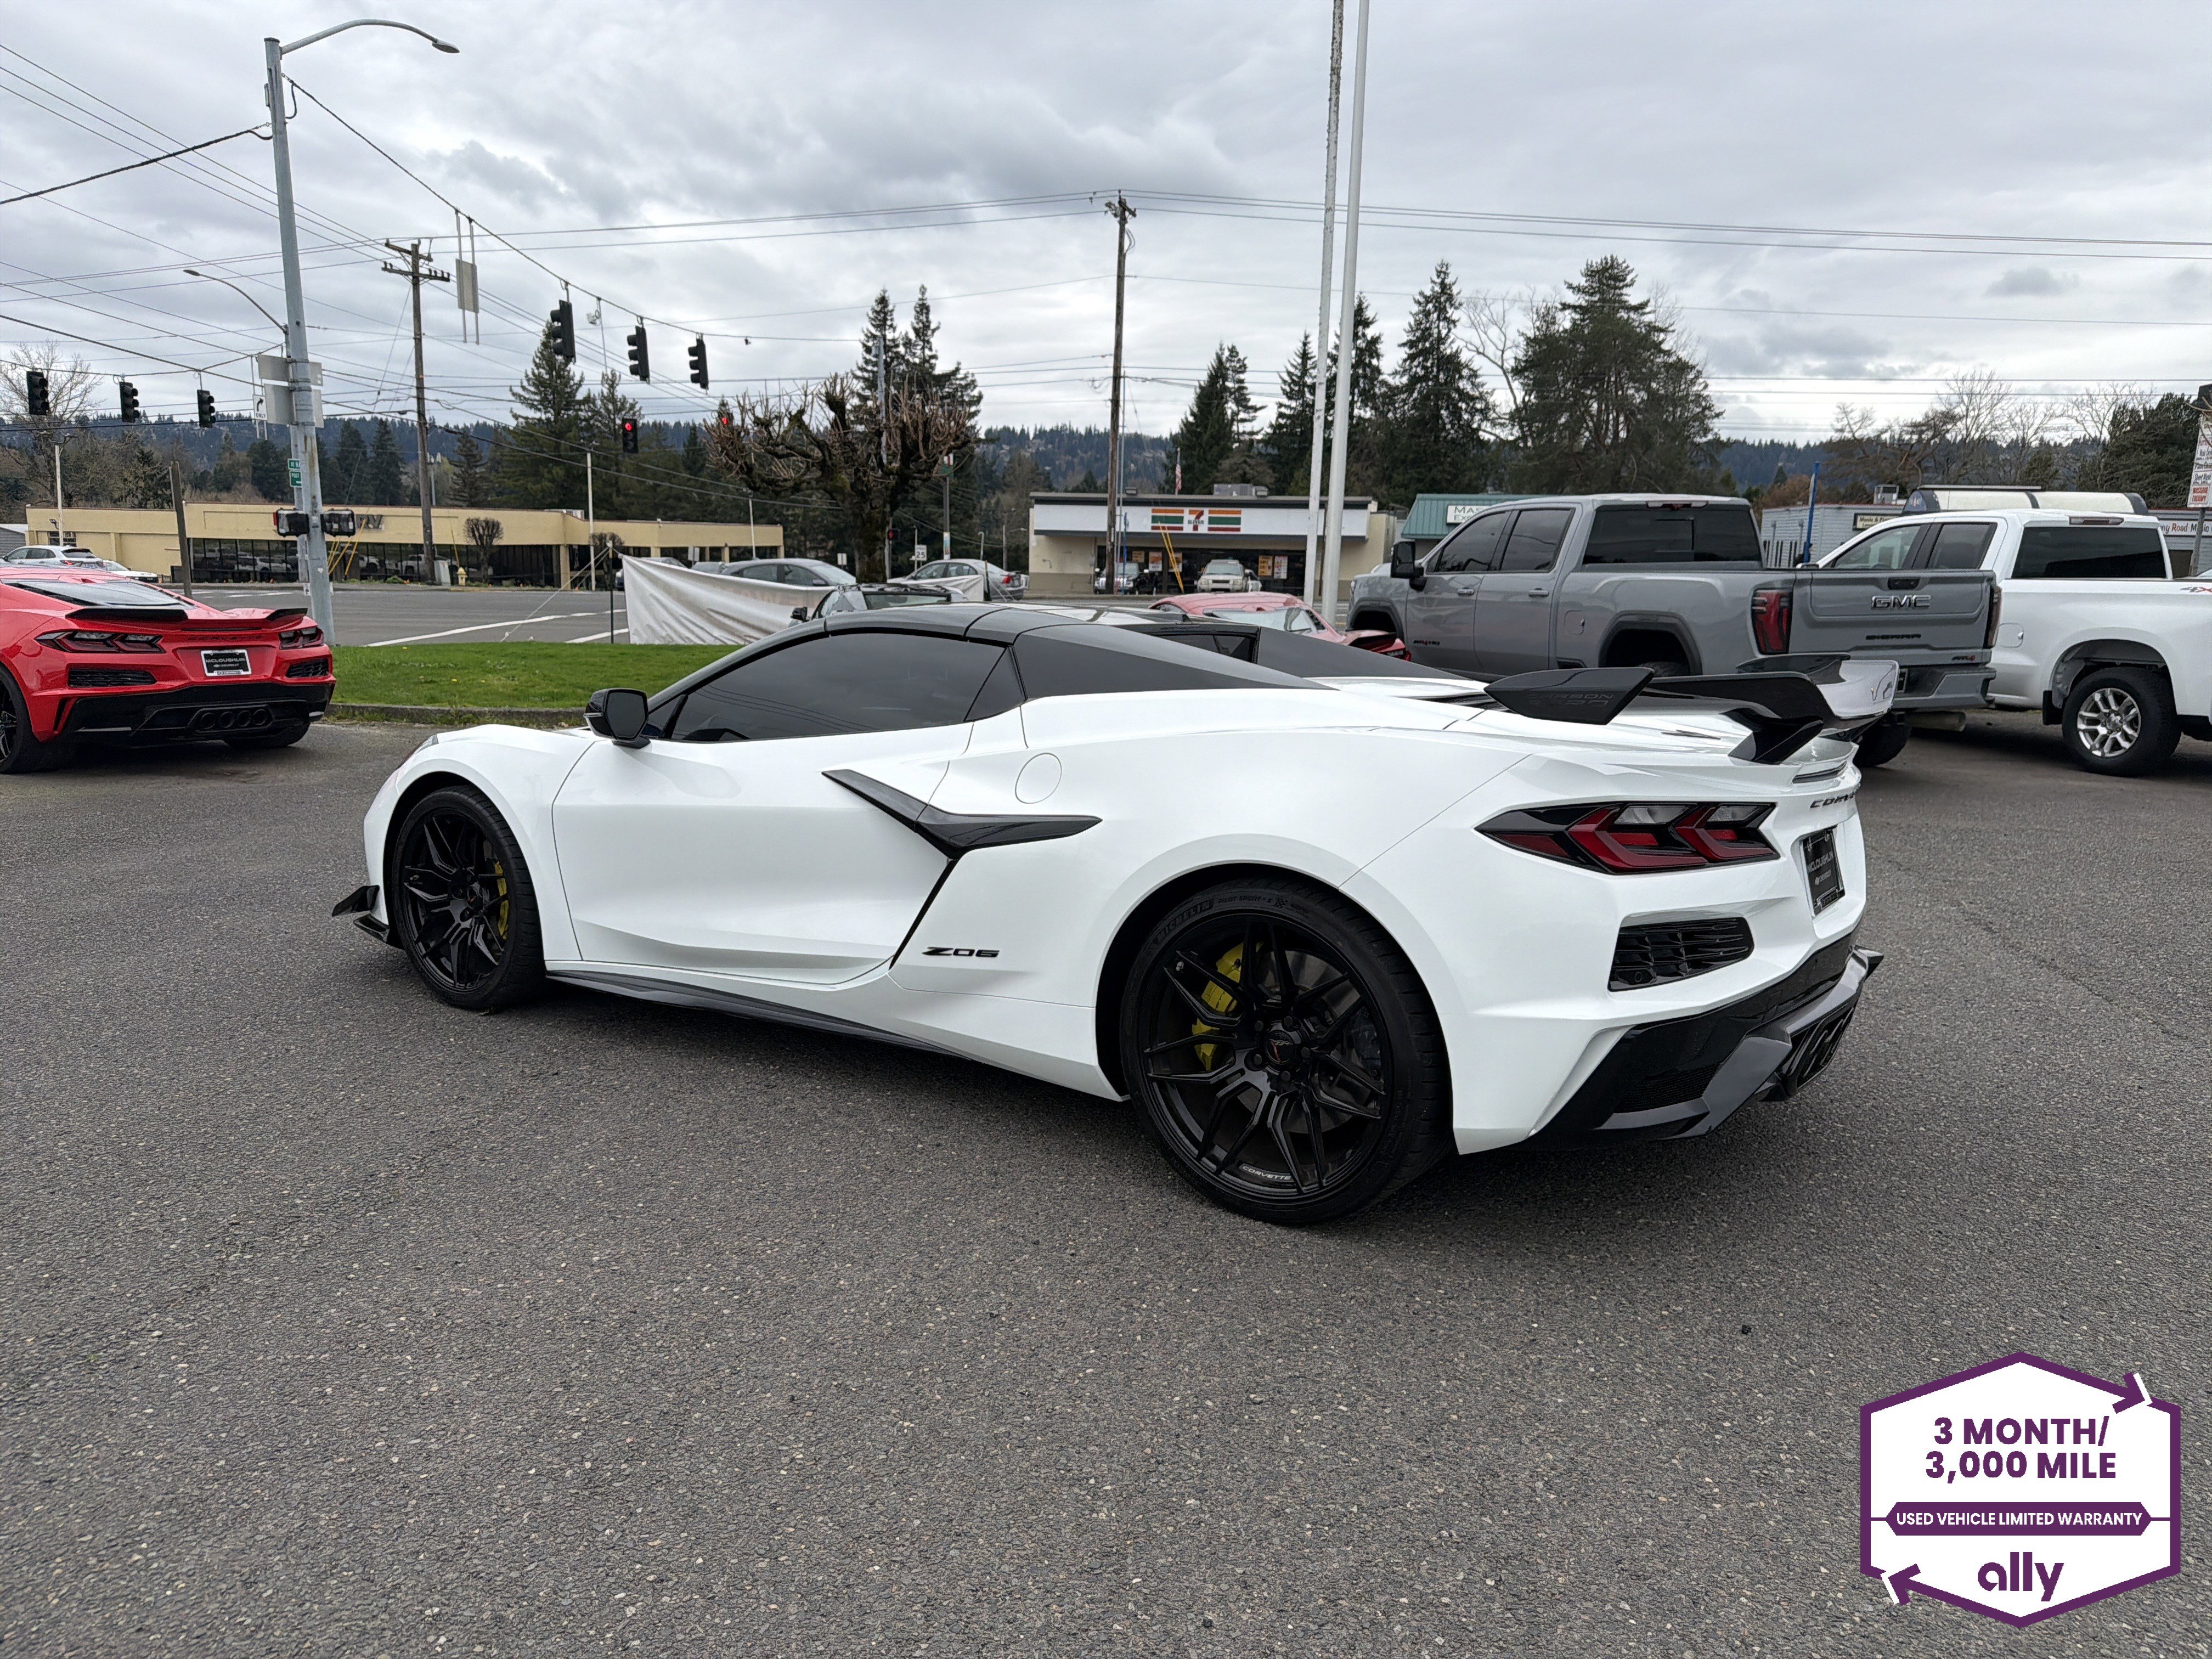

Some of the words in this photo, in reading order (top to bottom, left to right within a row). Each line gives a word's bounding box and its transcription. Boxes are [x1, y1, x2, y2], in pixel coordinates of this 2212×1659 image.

[2171, 523, 2188, 532] Road
[2191, 523, 2209, 532] Mic
[1871, 595, 1931, 610] GMC
[922, 947, 1000, 958] Z06
[1242, 1166, 1292, 1180] CORVETTE
